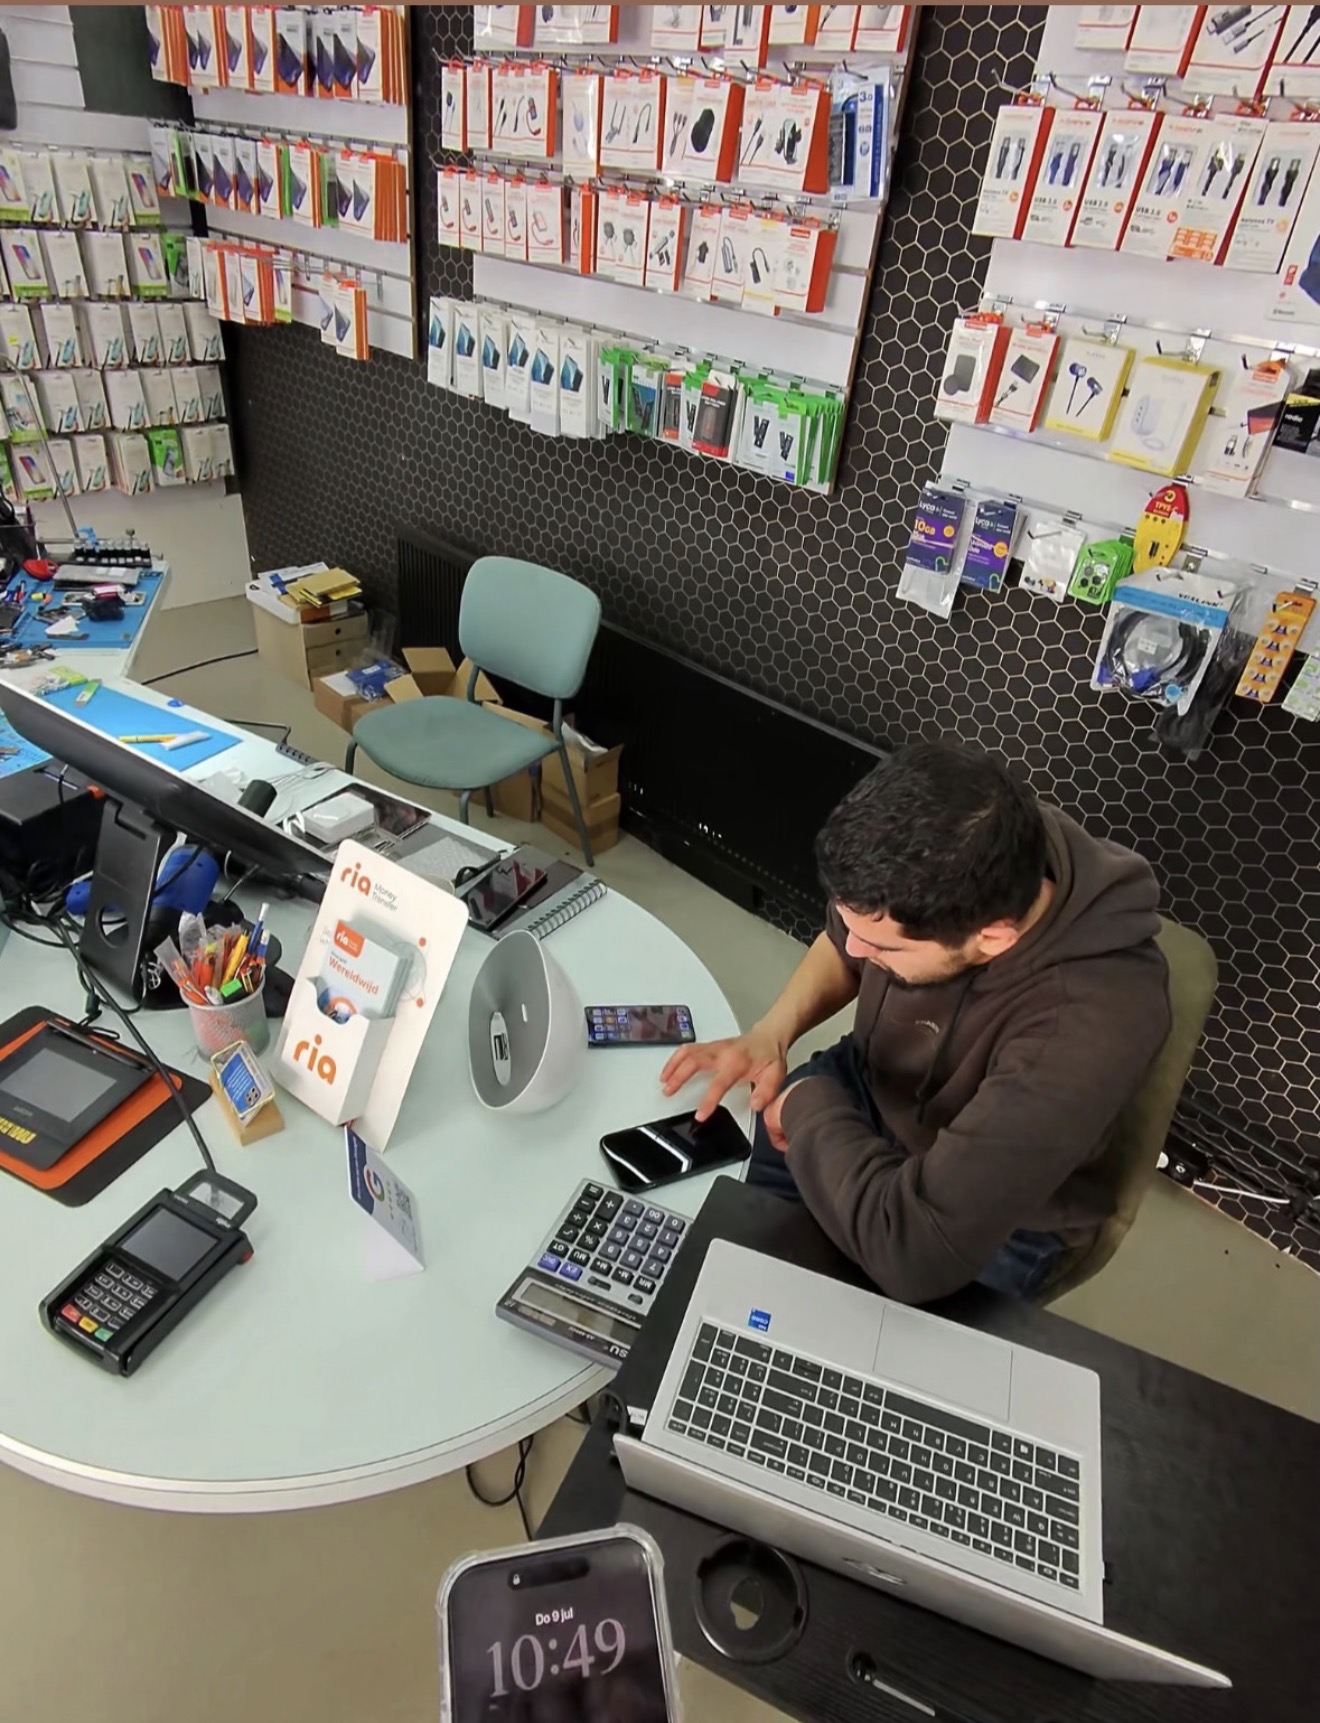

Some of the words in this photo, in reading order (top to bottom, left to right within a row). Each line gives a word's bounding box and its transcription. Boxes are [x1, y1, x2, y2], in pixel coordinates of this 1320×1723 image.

[914, 519, 936, 535] 10GB
[340, 862, 371, 896] ria
[372, 892, 398, 912] Transfer
[374, 883, 397, 902] Money
[336, 930, 348, 946] ria
[329, 956, 379, 995] Wereldwijd
[293, 1034, 337, 1086] ria
[649, 1210, 661, 1219] 00
[573, 1252, 586, 1260] MU
[649, 1262, 656, 1270] 7
[535, 1613, 551, 1626] Do
[552, 1610, 560, 1622] 9
[560, 1607, 574, 1623] jul
[487, 1618, 626, 1698] 10:49
